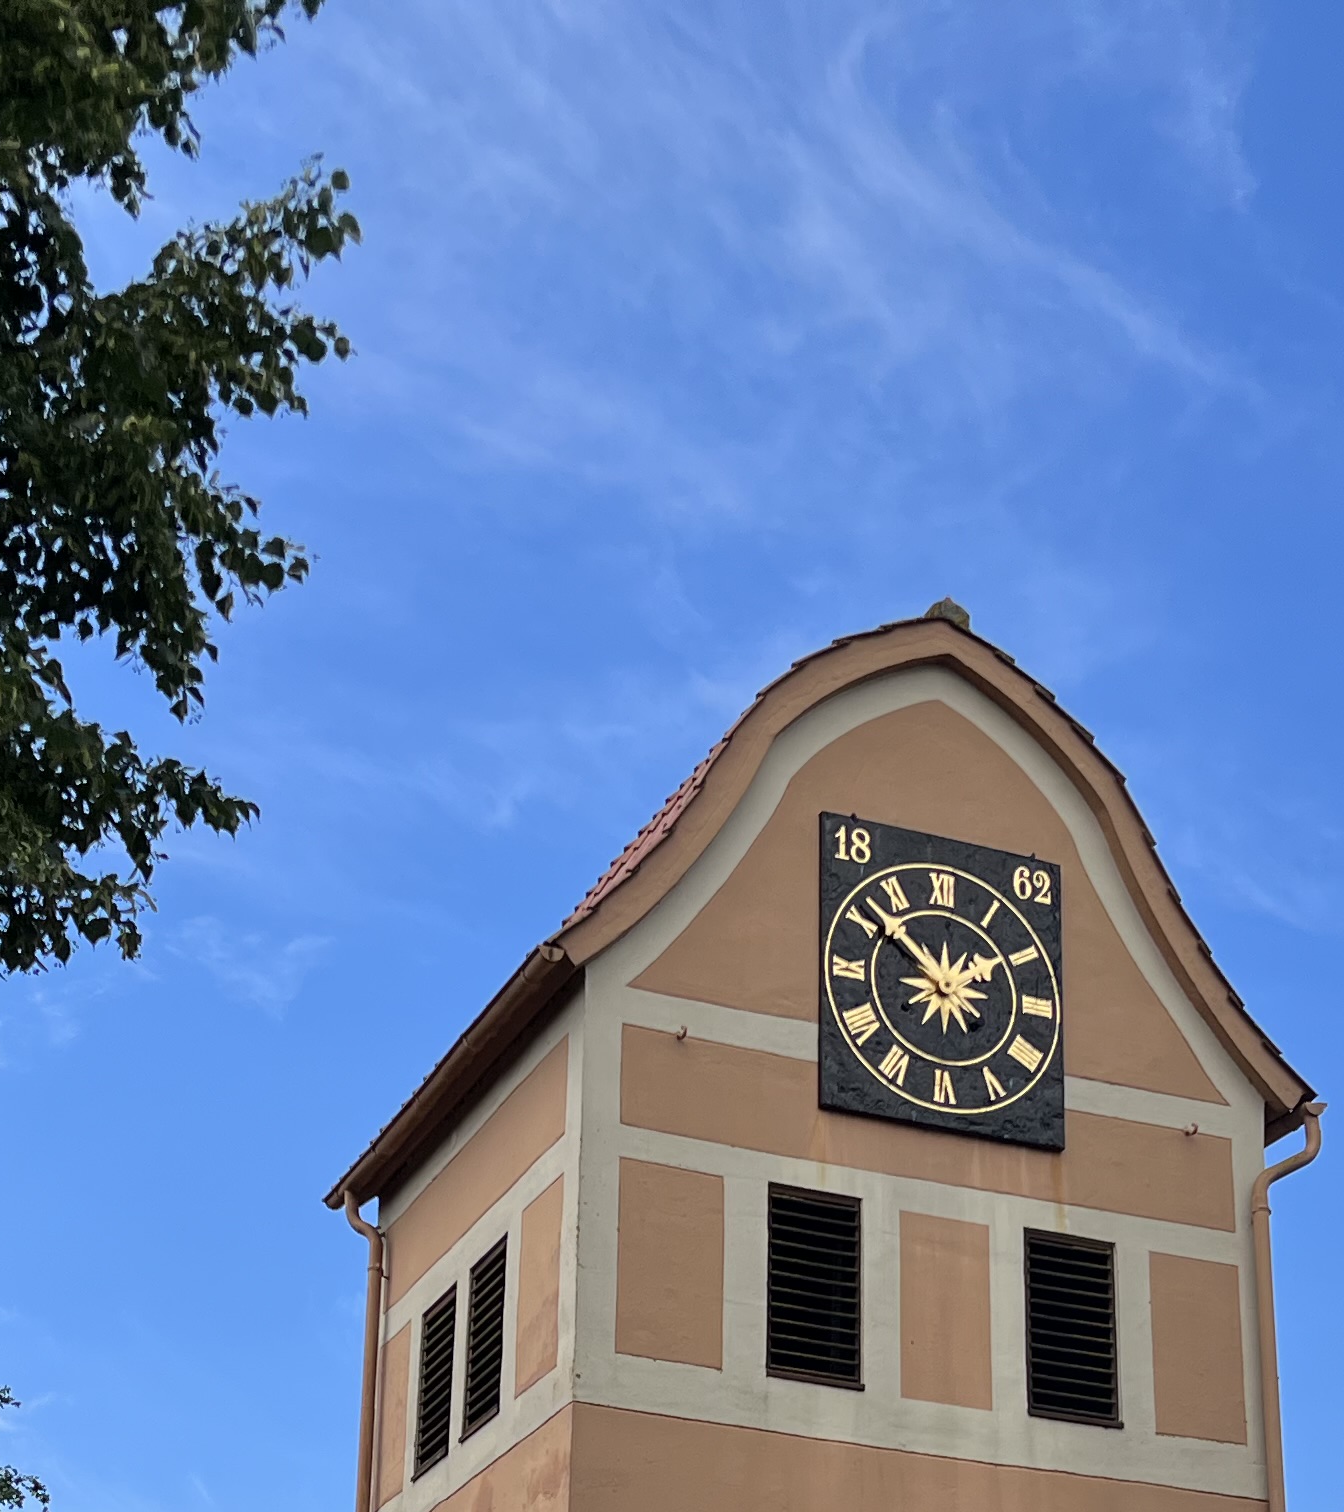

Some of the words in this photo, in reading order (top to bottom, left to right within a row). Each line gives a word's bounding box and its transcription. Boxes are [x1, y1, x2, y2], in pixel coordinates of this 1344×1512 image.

[834, 824, 870, 863] 18
[1013, 865, 1052, 906] 62
[879, 874, 910, 913] XI
[928, 871, 956, 909] XII
[844, 904, 879, 938] X
[832, 953, 866, 981] IX
[1008, 944, 1040, 967] II
[842, 1002, 881, 1046] VIII
[1022, 995, 1053, 1020] III
[877, 1043, 910, 1087] VII
[932, 1069, 957, 1105] VI
[982, 1066, 1007, 1101] V
